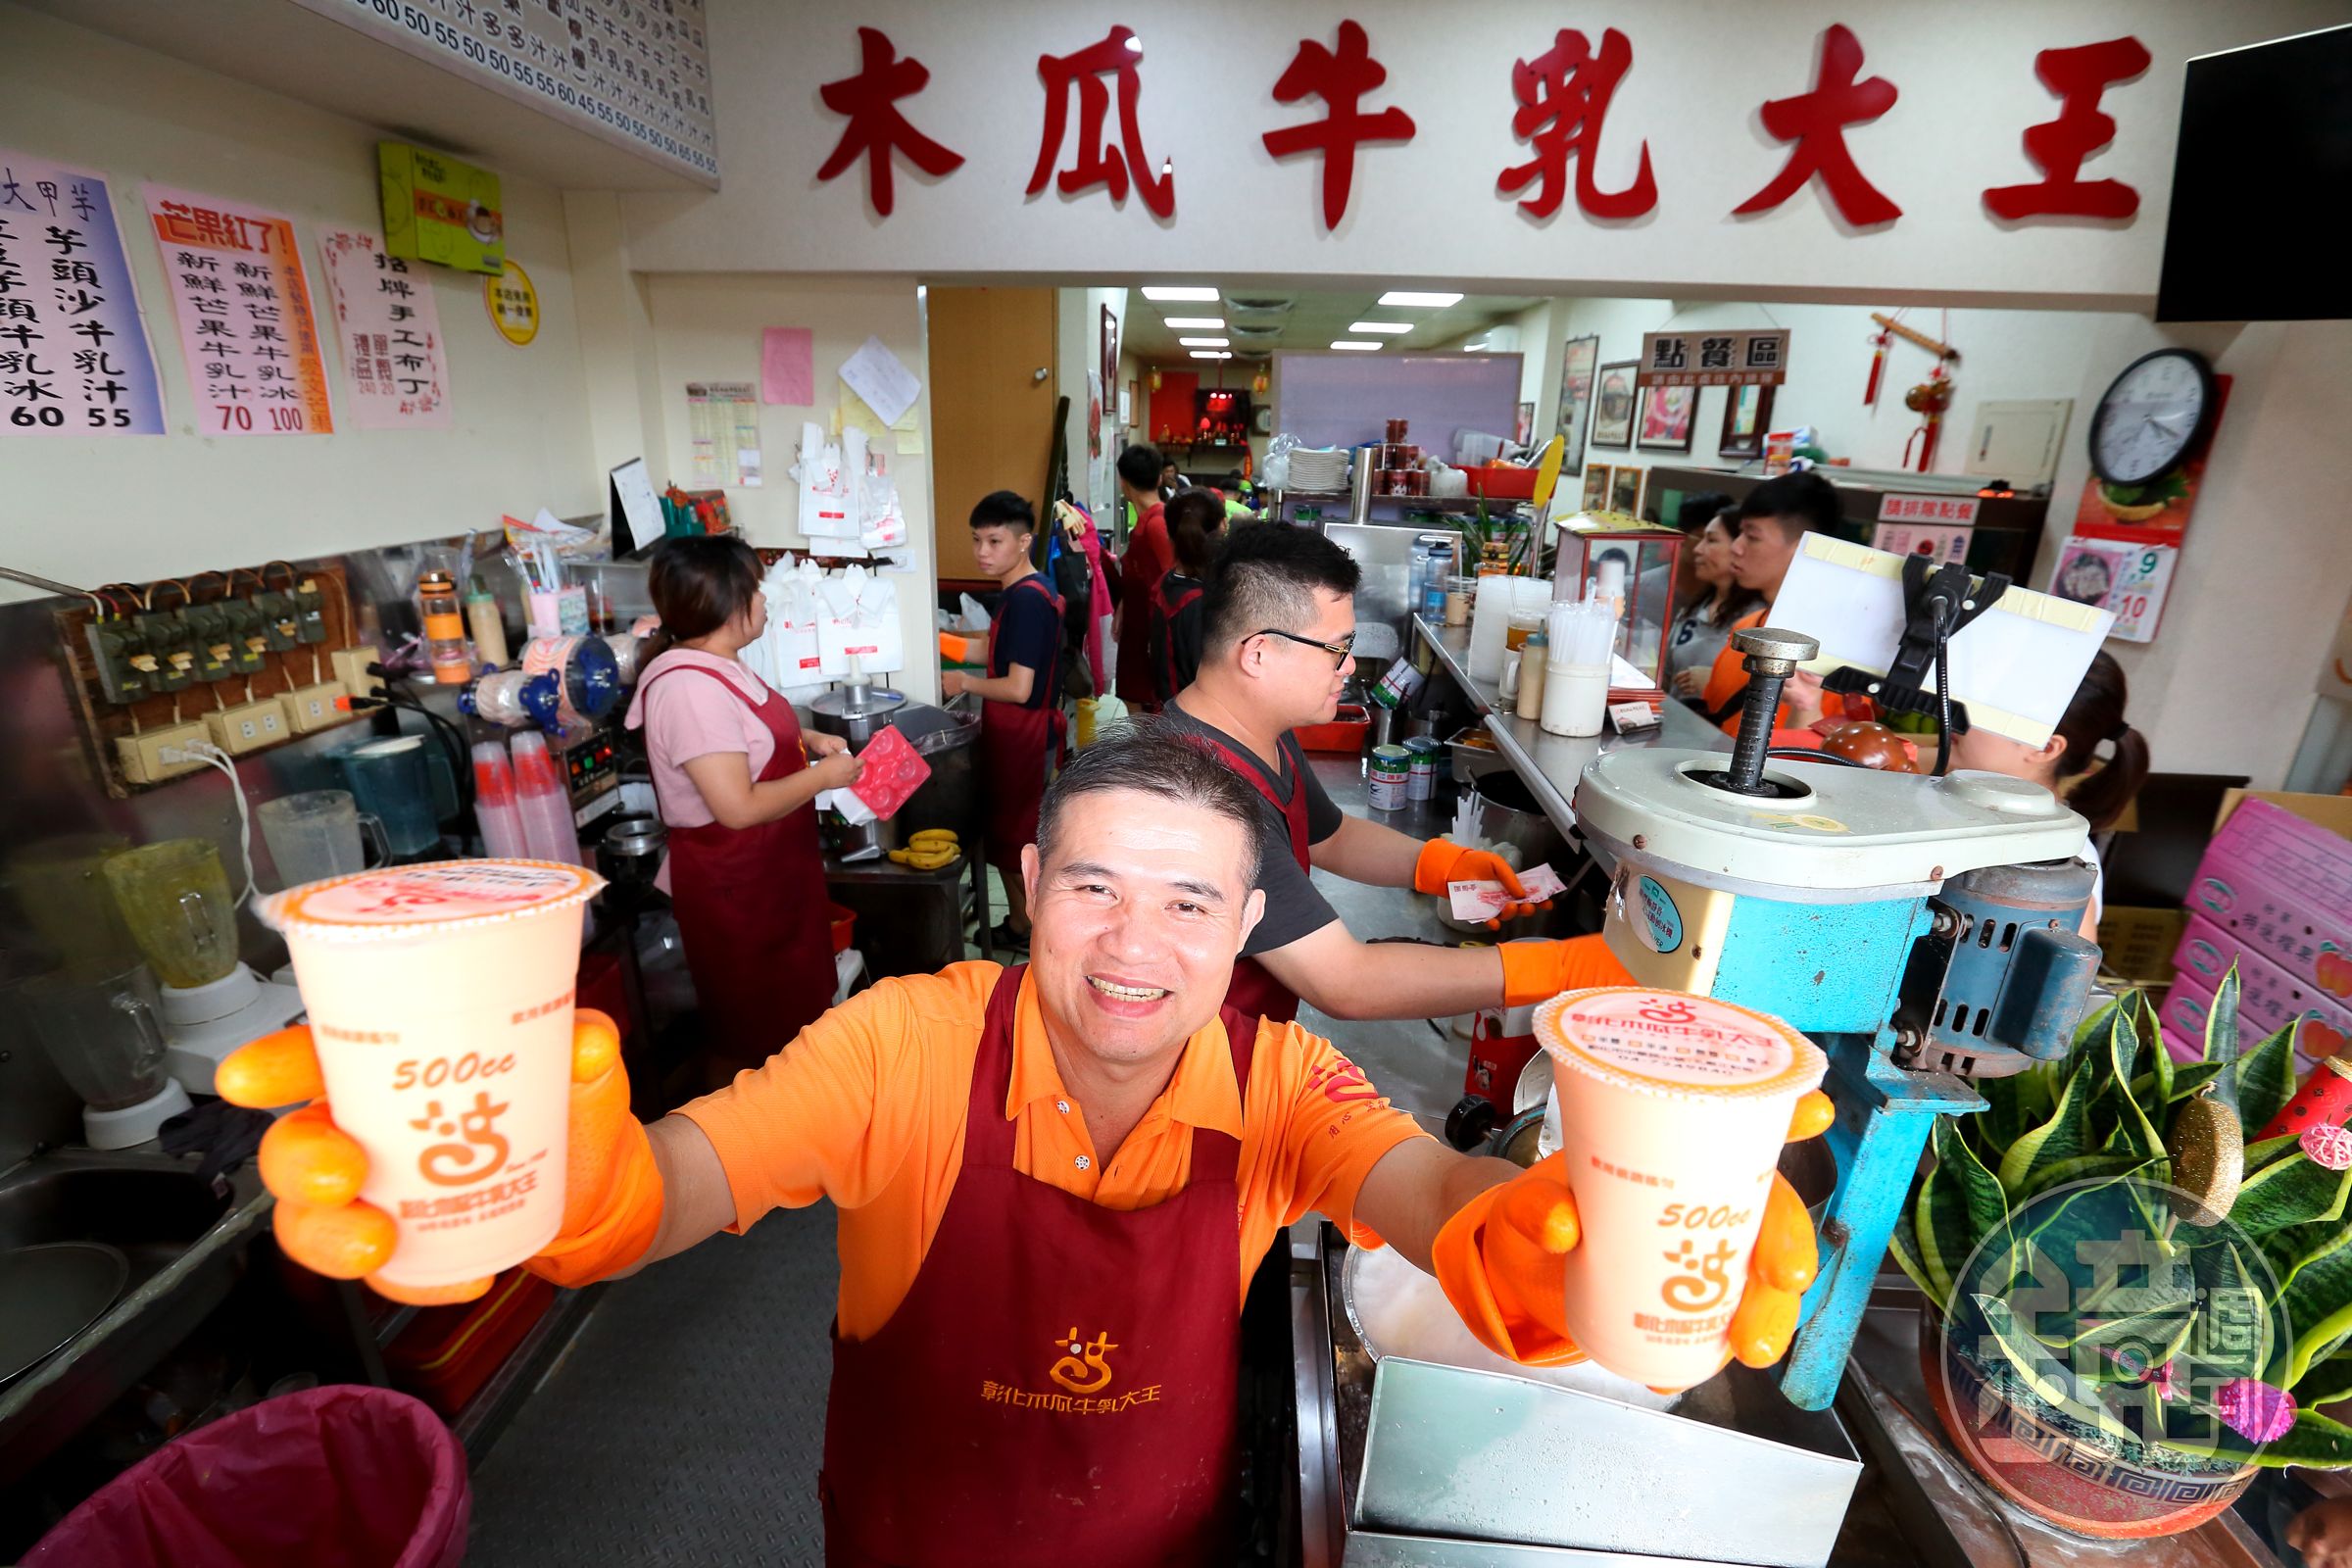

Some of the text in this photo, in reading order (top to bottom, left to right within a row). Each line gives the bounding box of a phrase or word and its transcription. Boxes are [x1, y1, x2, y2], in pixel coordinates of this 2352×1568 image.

[405, 6, 430, 35] 50
[434, 22, 459, 50] 55
[463, 36, 485, 63] 50
[489, 50, 510, 74] 50
[514, 61, 533, 85] 55
[536, 73, 556, 96] 55
[558, 83, 575, 106] 60
[578, 95, 595, 115] 45
[597, 102, 613, 123] 55
[615, 112, 630, 131] 50
[632, 121, 647, 140] 55
[649, 128, 662, 148] 50
[664, 136, 677, 155] 50
[817, 19, 2152, 231] 木瓜牛乳大王
[3, 168, 96, 221] 大甲芋
[160, 200, 287, 254] 芒果紅了!
[45, 226, 127, 404] 芋頭沙牛乳汁
[176, 252, 247, 400] 新鮮芒果牛乳汁
[233, 262, 299, 400] 新鮮芒果牛乳冰
[1653, 336, 1783, 368] 點餐區
[11, 407, 64, 426] 60
[88, 408, 130, 427] 55
[216, 405, 252, 430] 70
[269, 408, 303, 431] 100
[2139, 552, 2157, 574] 9
[2121, 595, 2146, 618] 10
[392, 1052, 516, 1091] 500cc
[1656, 1202, 1752, 1229] 500cc
[980, 1380, 1162, 1415] 彰化木瓜牛乳大王
